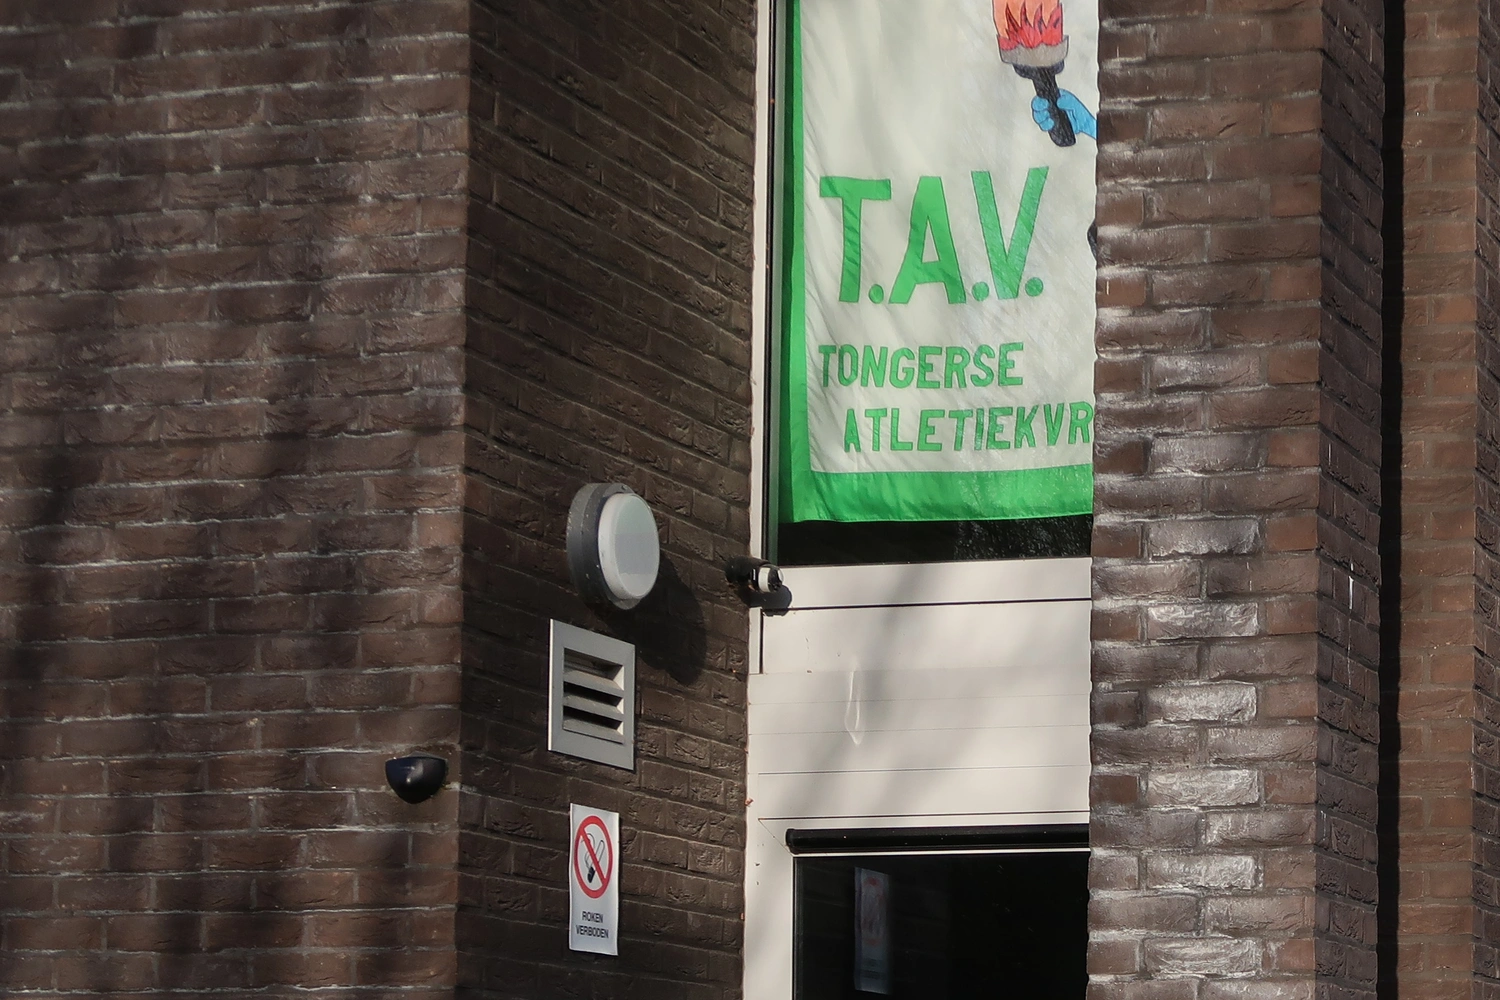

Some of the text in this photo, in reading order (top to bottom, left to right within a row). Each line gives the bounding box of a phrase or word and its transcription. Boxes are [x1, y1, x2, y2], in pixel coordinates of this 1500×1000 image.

[819, 166, 1049, 305] T.A.V.
[818, 342, 1024, 389] TONGERSE
[576, 925, 609, 938] VERBODEN
[582, 911, 603, 923] ROKEN
